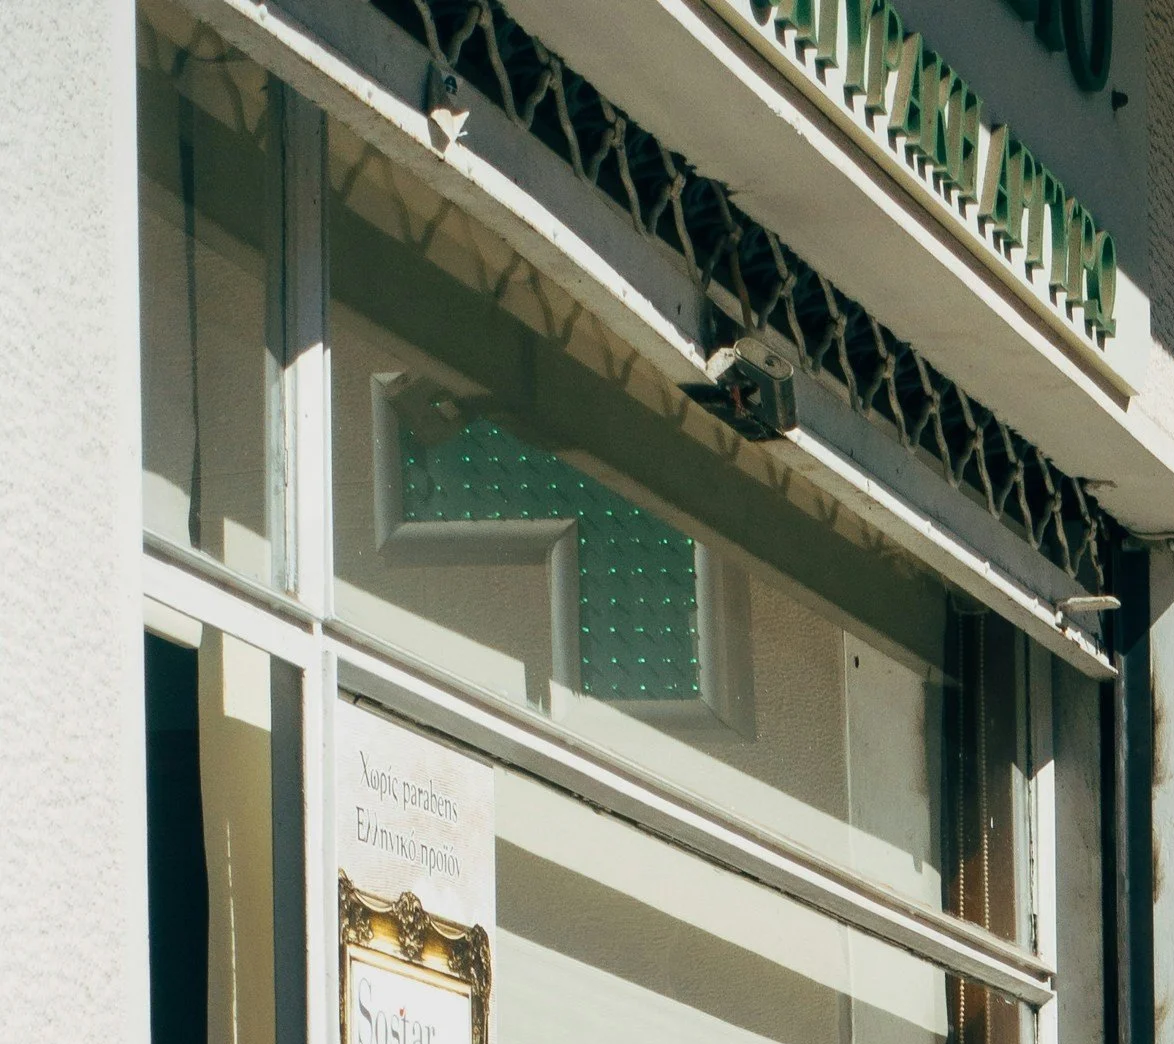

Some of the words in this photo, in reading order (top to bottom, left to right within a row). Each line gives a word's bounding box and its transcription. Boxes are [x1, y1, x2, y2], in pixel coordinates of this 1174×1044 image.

[359, 750, 398, 802] Χωρίς
[403, 780, 458, 823] parabens
[356, 806, 416, 861] Ελληνικό
[420, 844, 462, 878] προϊόν
